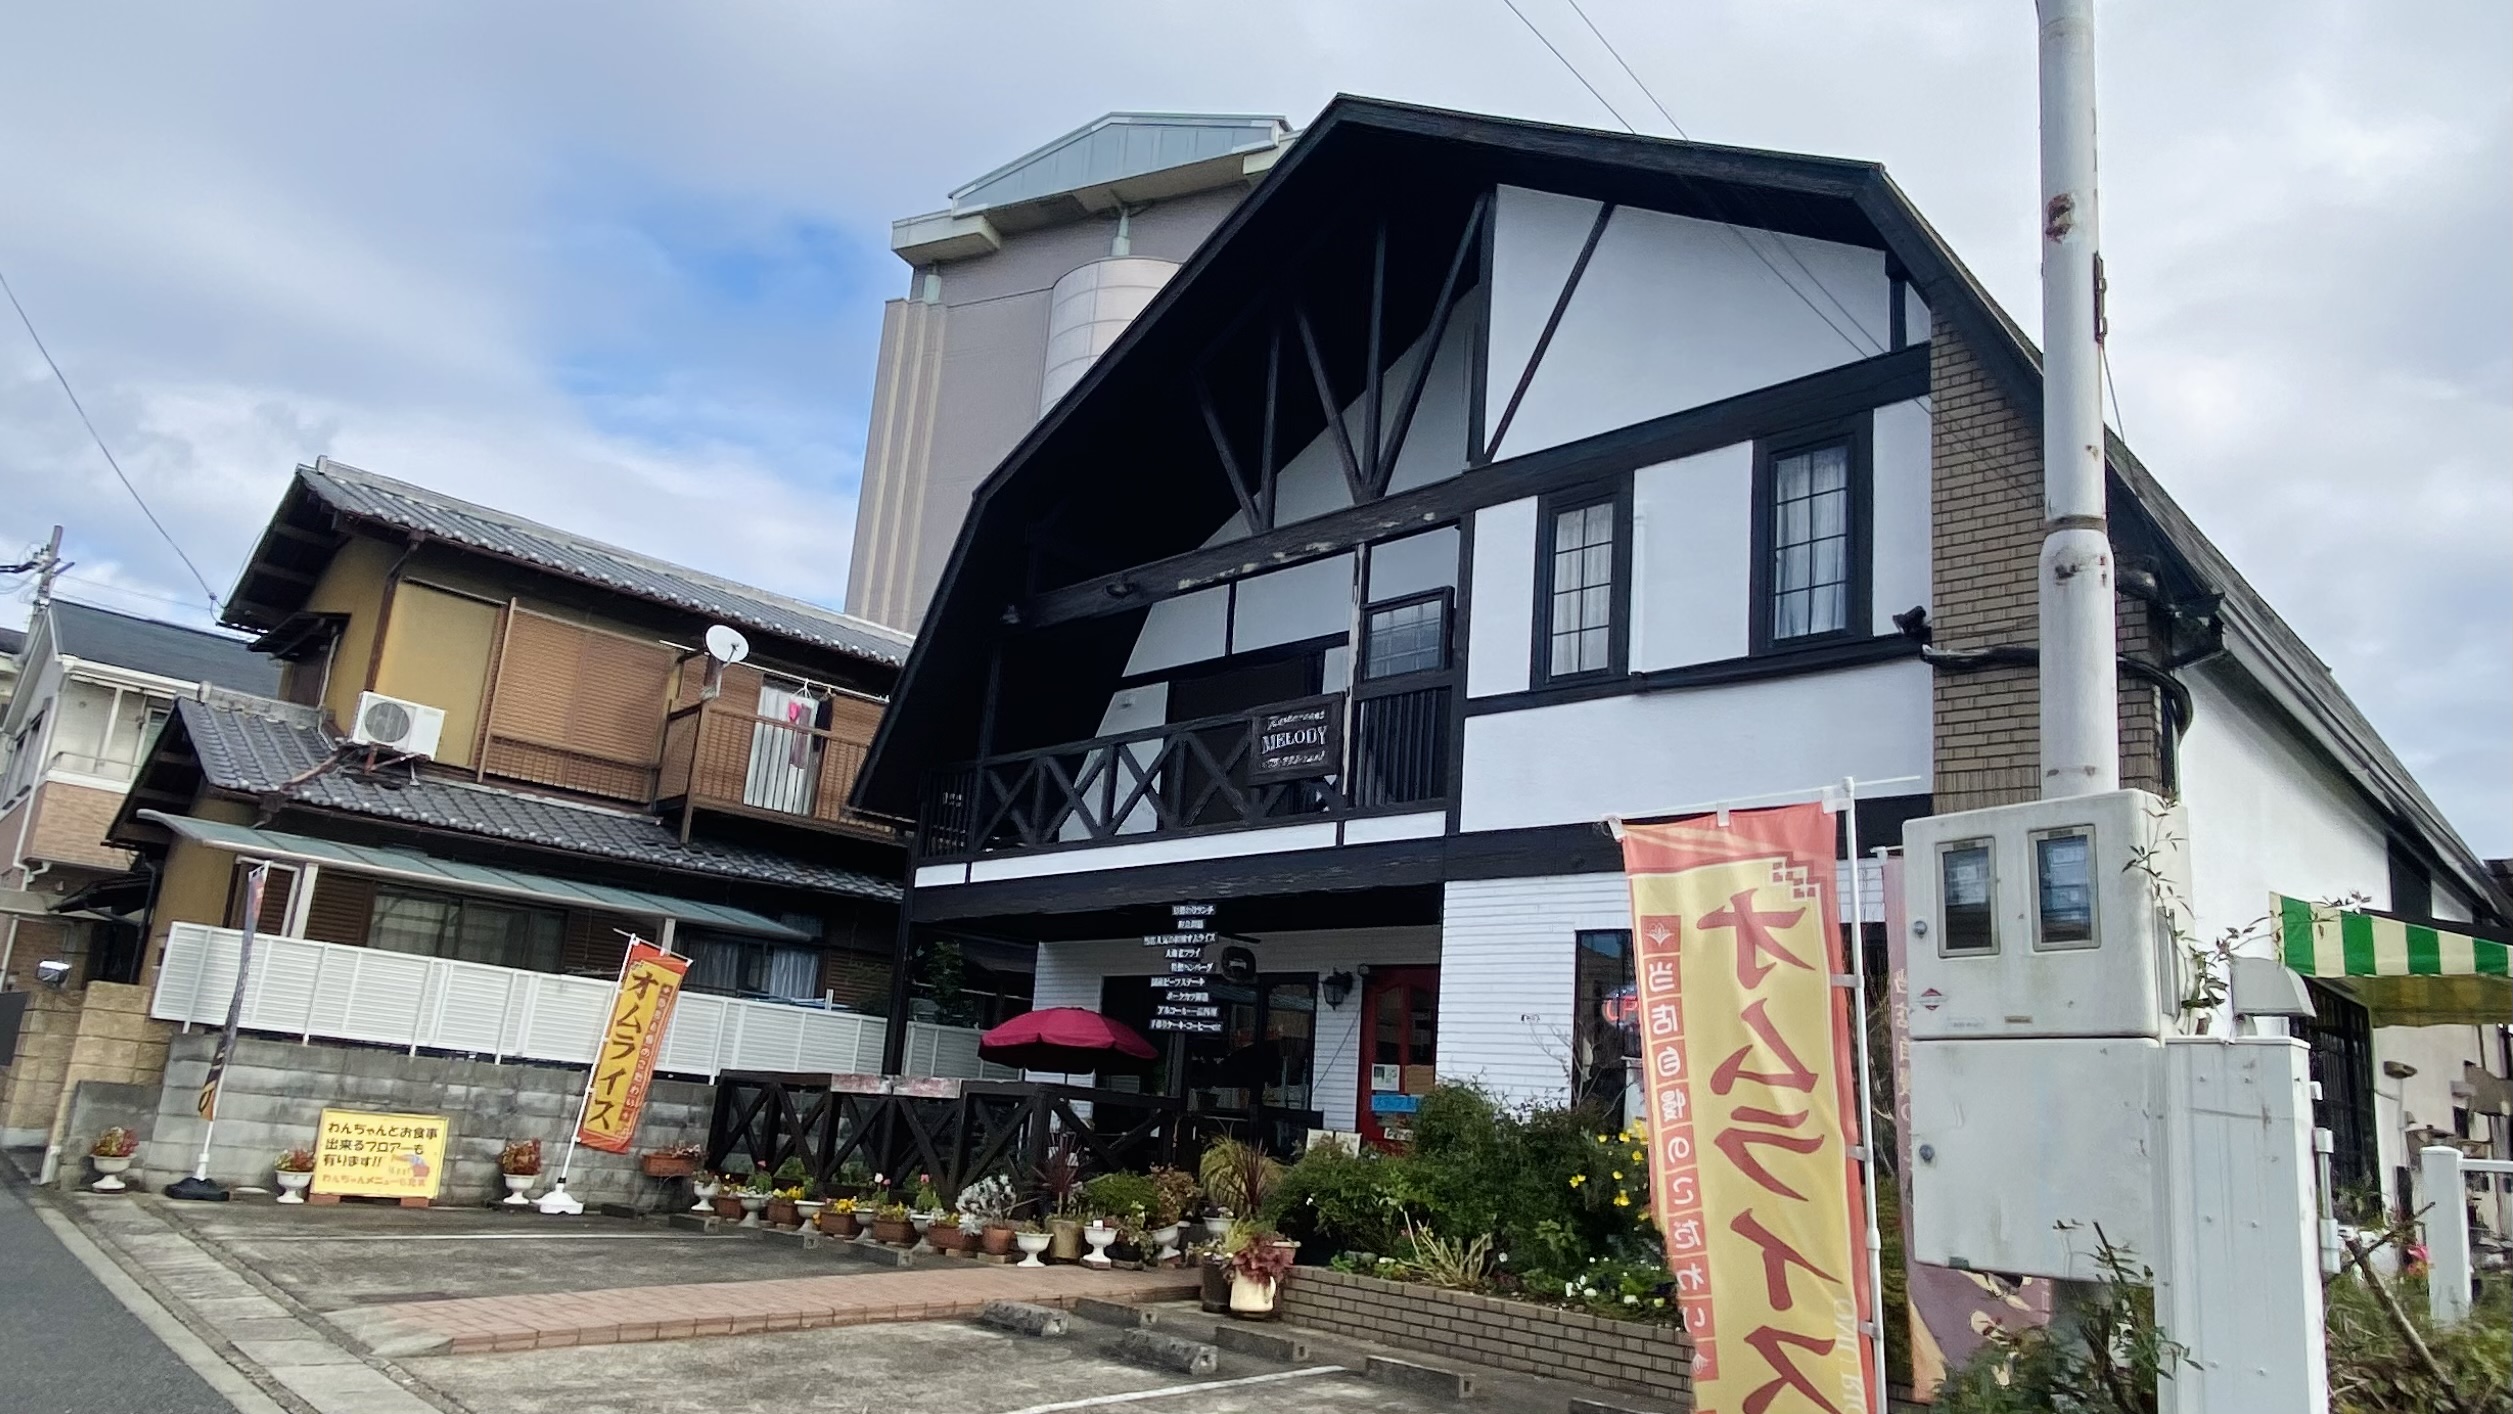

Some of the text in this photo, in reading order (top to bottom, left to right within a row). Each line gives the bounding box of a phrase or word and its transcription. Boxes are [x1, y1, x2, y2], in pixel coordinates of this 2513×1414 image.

[1262, 725, 1328, 755] MELODY
[586, 970, 659, 1131] オムライス
[328, 1122, 439, 1140] わんちゃんとお食事
[325, 1138, 424, 1155] 出来るフロアーも
